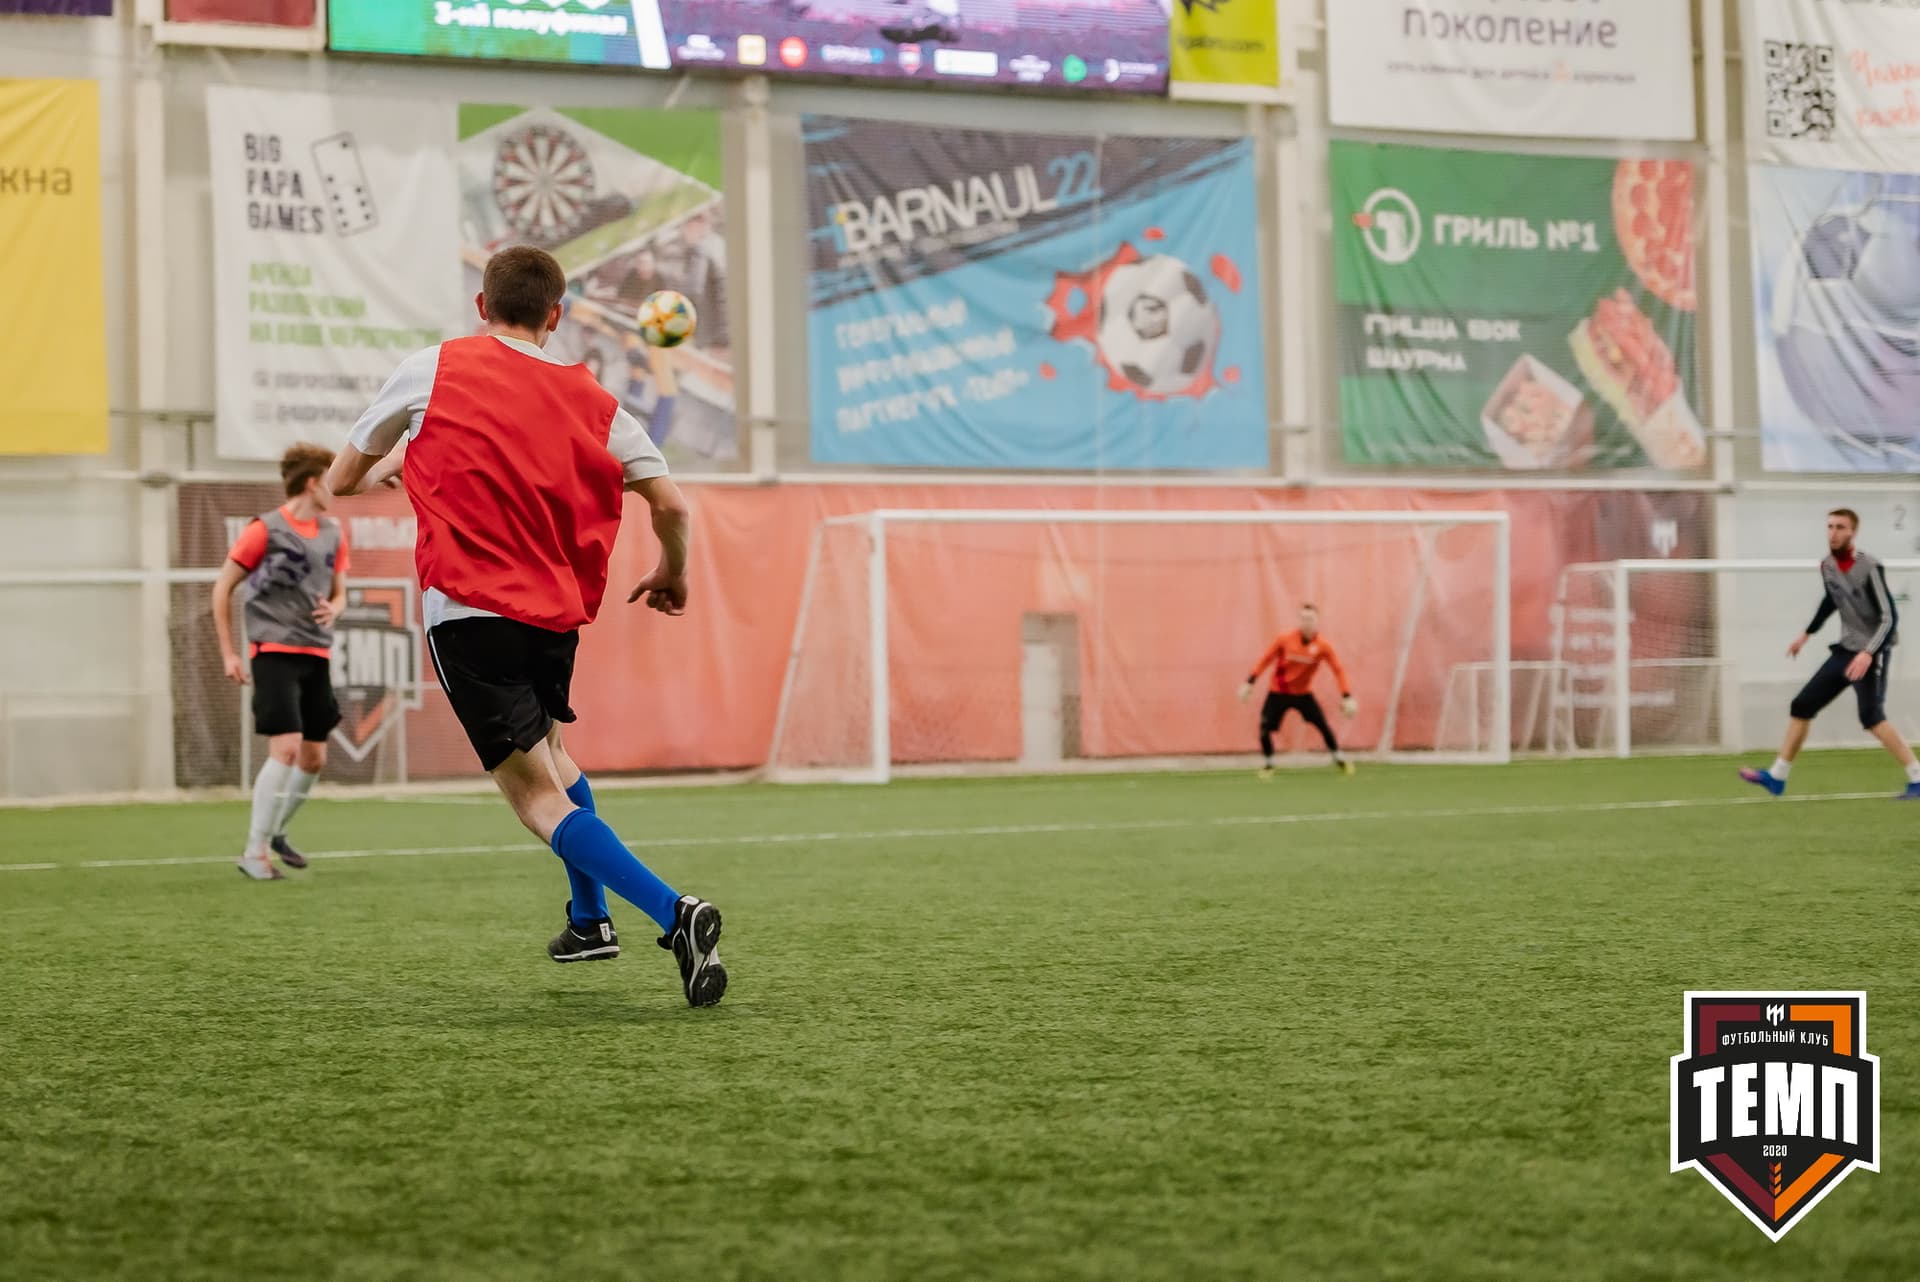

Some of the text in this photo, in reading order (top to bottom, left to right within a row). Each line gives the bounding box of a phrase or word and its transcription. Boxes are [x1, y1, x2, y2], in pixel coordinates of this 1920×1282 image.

[1403, 7, 1618, 48] поколение
[244, 132, 282, 162] BIG
[246, 168, 304, 198] PAPA
[247, 201, 324, 234] GAMES
[1433, 213, 1600, 252] ГРИЛЬ №1
